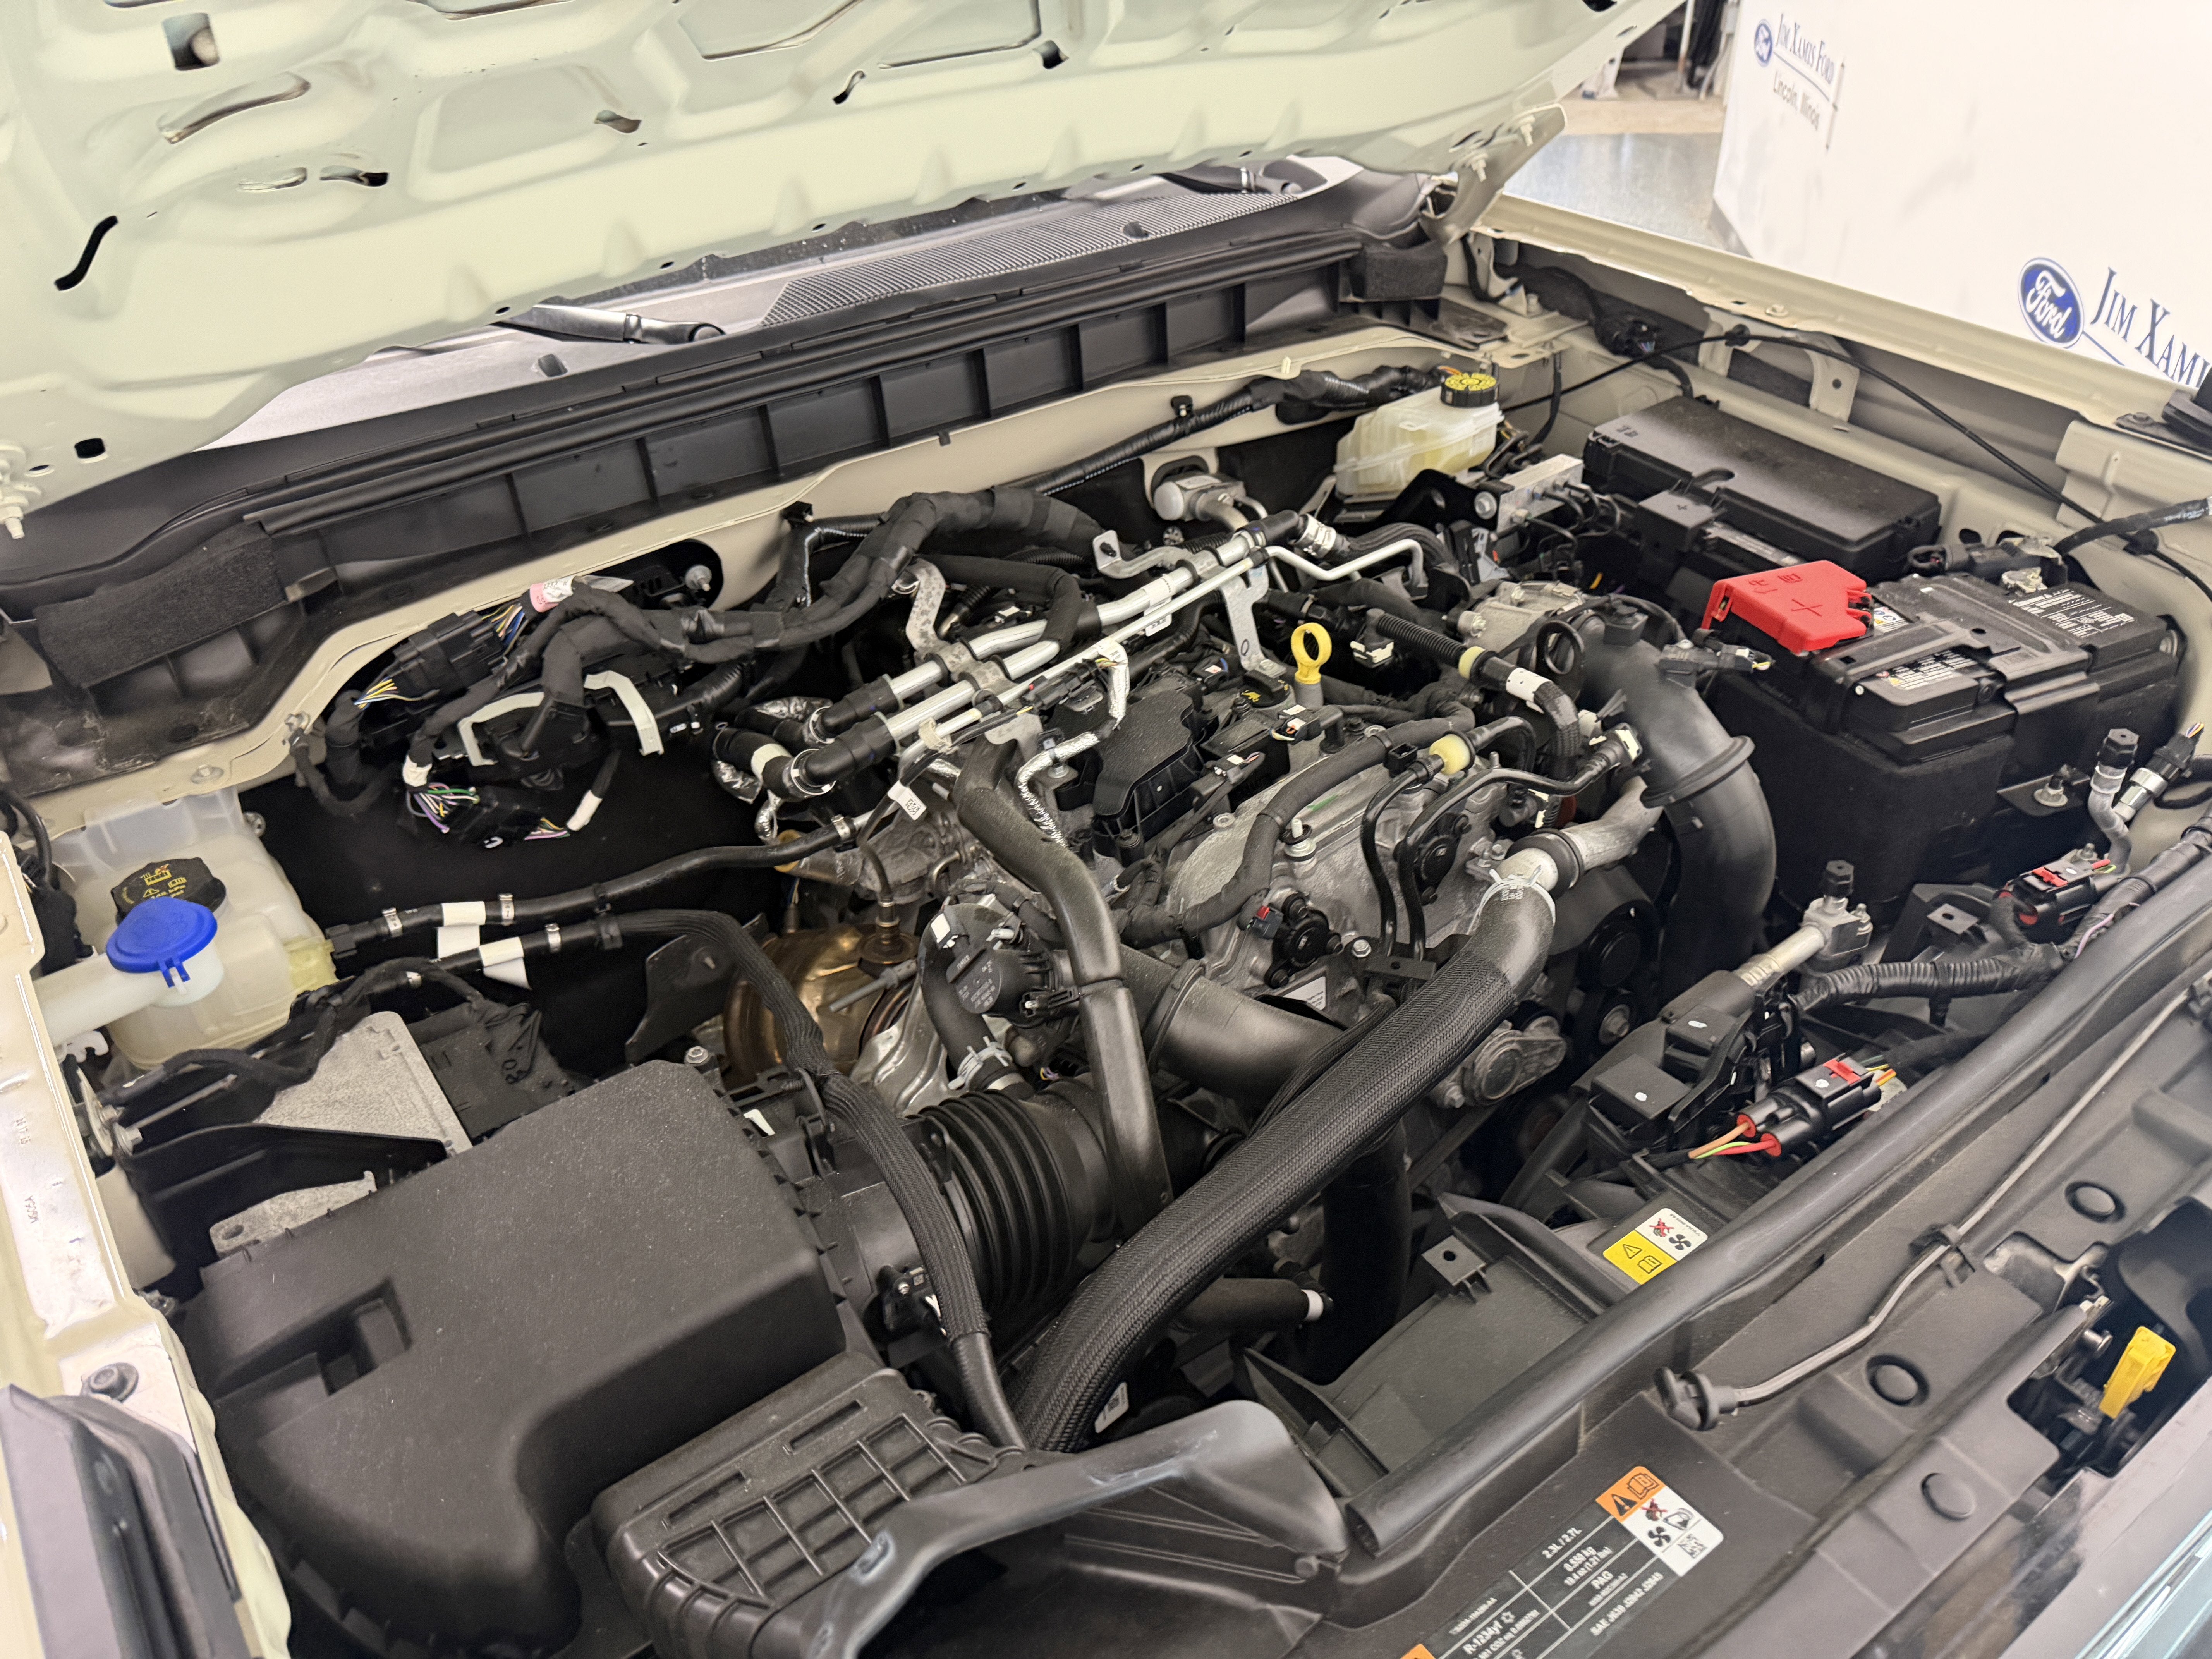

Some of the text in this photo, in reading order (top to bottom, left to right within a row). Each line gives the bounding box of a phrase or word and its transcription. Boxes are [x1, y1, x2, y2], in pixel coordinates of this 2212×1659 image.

[2025, 270, 2073, 339] Ford
[2090, 266, 2211, 388] JIM XAMI
[1591, 1571, 1614, 1590] PAG
[1462, 1620, 1503, 1655] R-1234yf
[1590, 1618, 1611, 1637] SAE
